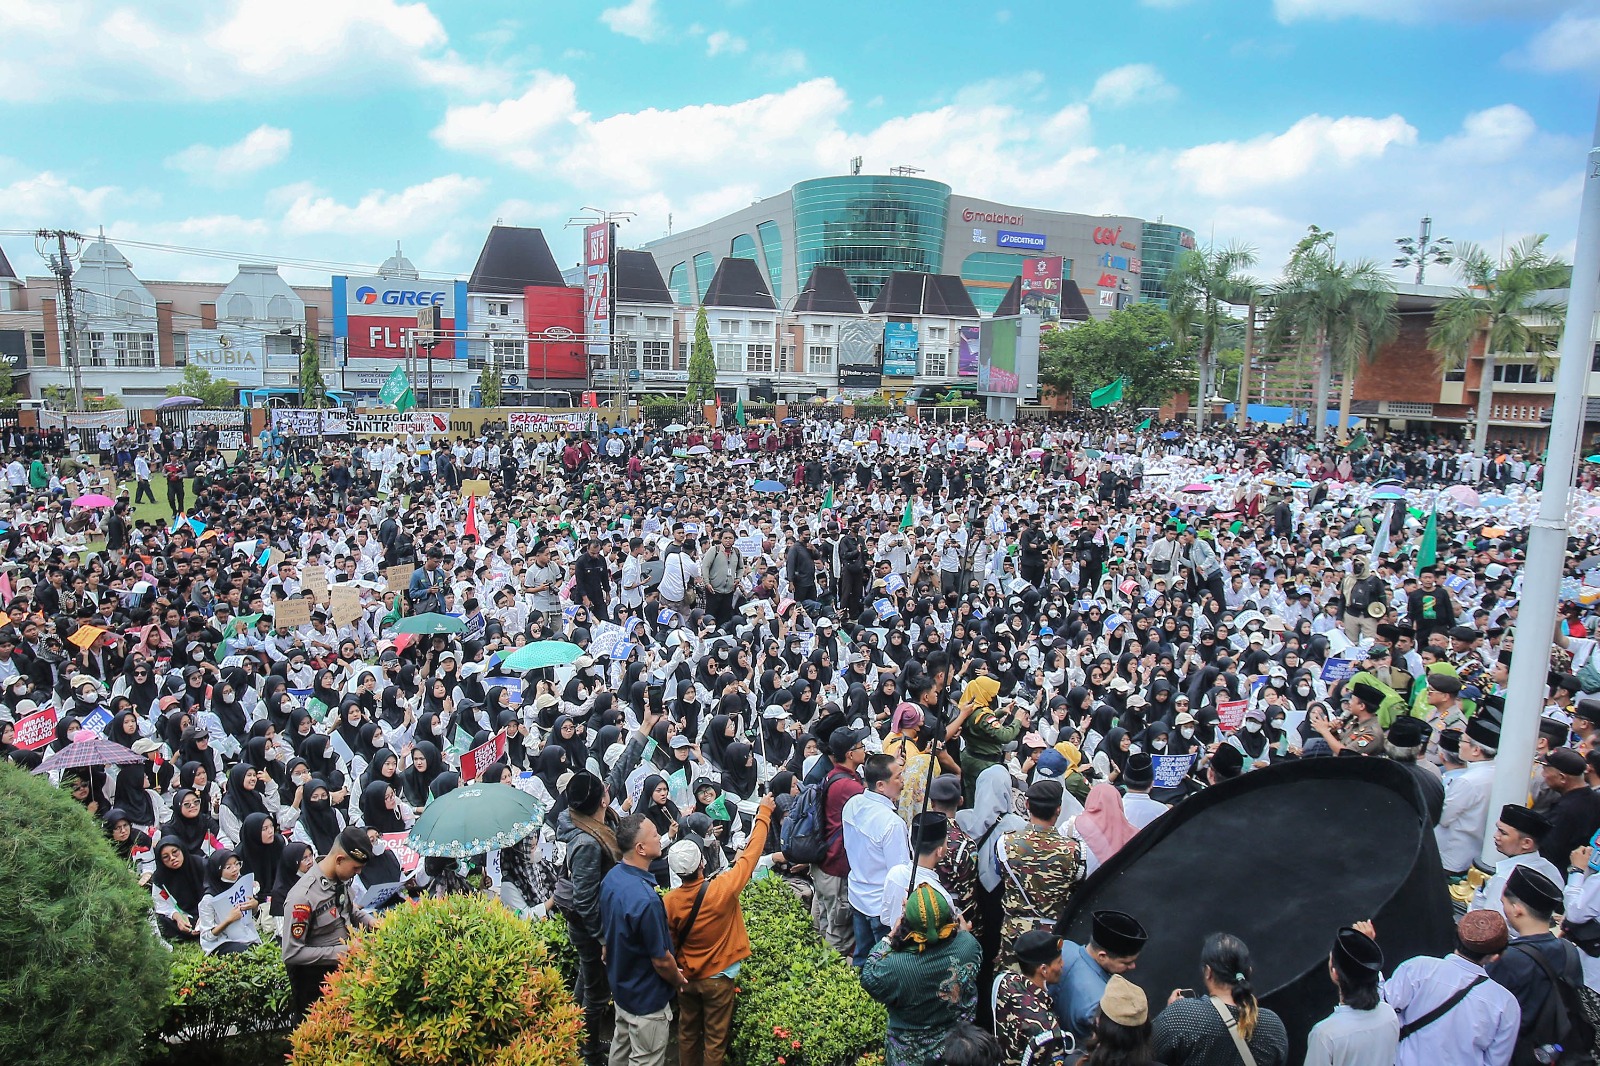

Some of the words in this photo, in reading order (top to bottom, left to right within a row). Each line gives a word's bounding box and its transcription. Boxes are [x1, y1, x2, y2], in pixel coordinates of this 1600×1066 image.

[975, 212, 1024, 226] matahari
[1009, 236, 1044, 246] DECATHLON
[382, 289, 446, 306] GREE
[196, 350, 256, 365] NUBIA
[327, 411, 360, 420] MIRAS
[367, 413, 413, 422] DITEGUK
[510, 424, 530, 433] BAR
[17, 719, 52, 737] DILARANG
[22, 715, 45, 730] MIRAS
[82, 711, 103, 731] NTRI
[24, 731, 52, 746] TENANG
[474, 740, 496, 758] ISLAM
[475, 747, 497, 763] TEGAS
[475, 753, 497, 769] TOLAK
